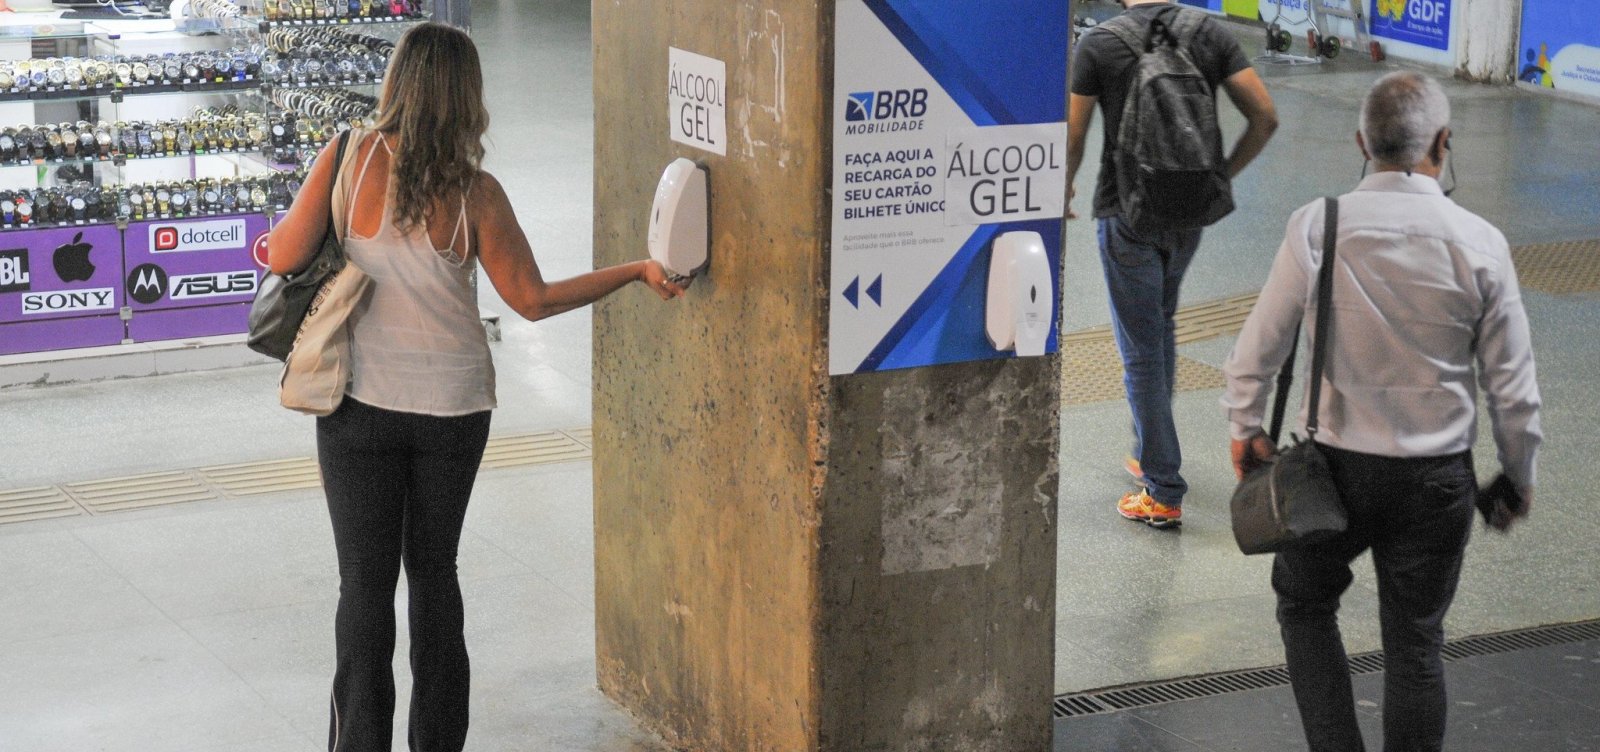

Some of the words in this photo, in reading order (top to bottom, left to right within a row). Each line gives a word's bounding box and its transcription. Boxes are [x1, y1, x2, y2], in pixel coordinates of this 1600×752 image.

[1408, 0, 1446, 24] GDF
[669, 62, 722, 107] ÁLCOOL
[875, 88, 928, 120] BRB
[681, 102, 715, 145] GEL
[845, 120, 924, 136] MOBILIDADE
[845, 152, 882, 168] FAÇA
[885, 149, 920, 164] AQUI
[923, 147, 934, 160] A
[946, 142, 1060, 178] ÁLCOOL
[845, 168, 912, 184] RECARGA
[916, 165, 937, 178] DO
[844, 189, 872, 202] SEU
[875, 181, 932, 199] CARTÃO
[969, 176, 1042, 216] GEL
[844, 203, 902, 220] BILHETE
[181, 225, 239, 244] dotcell
[172, 272, 255, 297] ASUS
[24, 291, 112, 311] SONY
